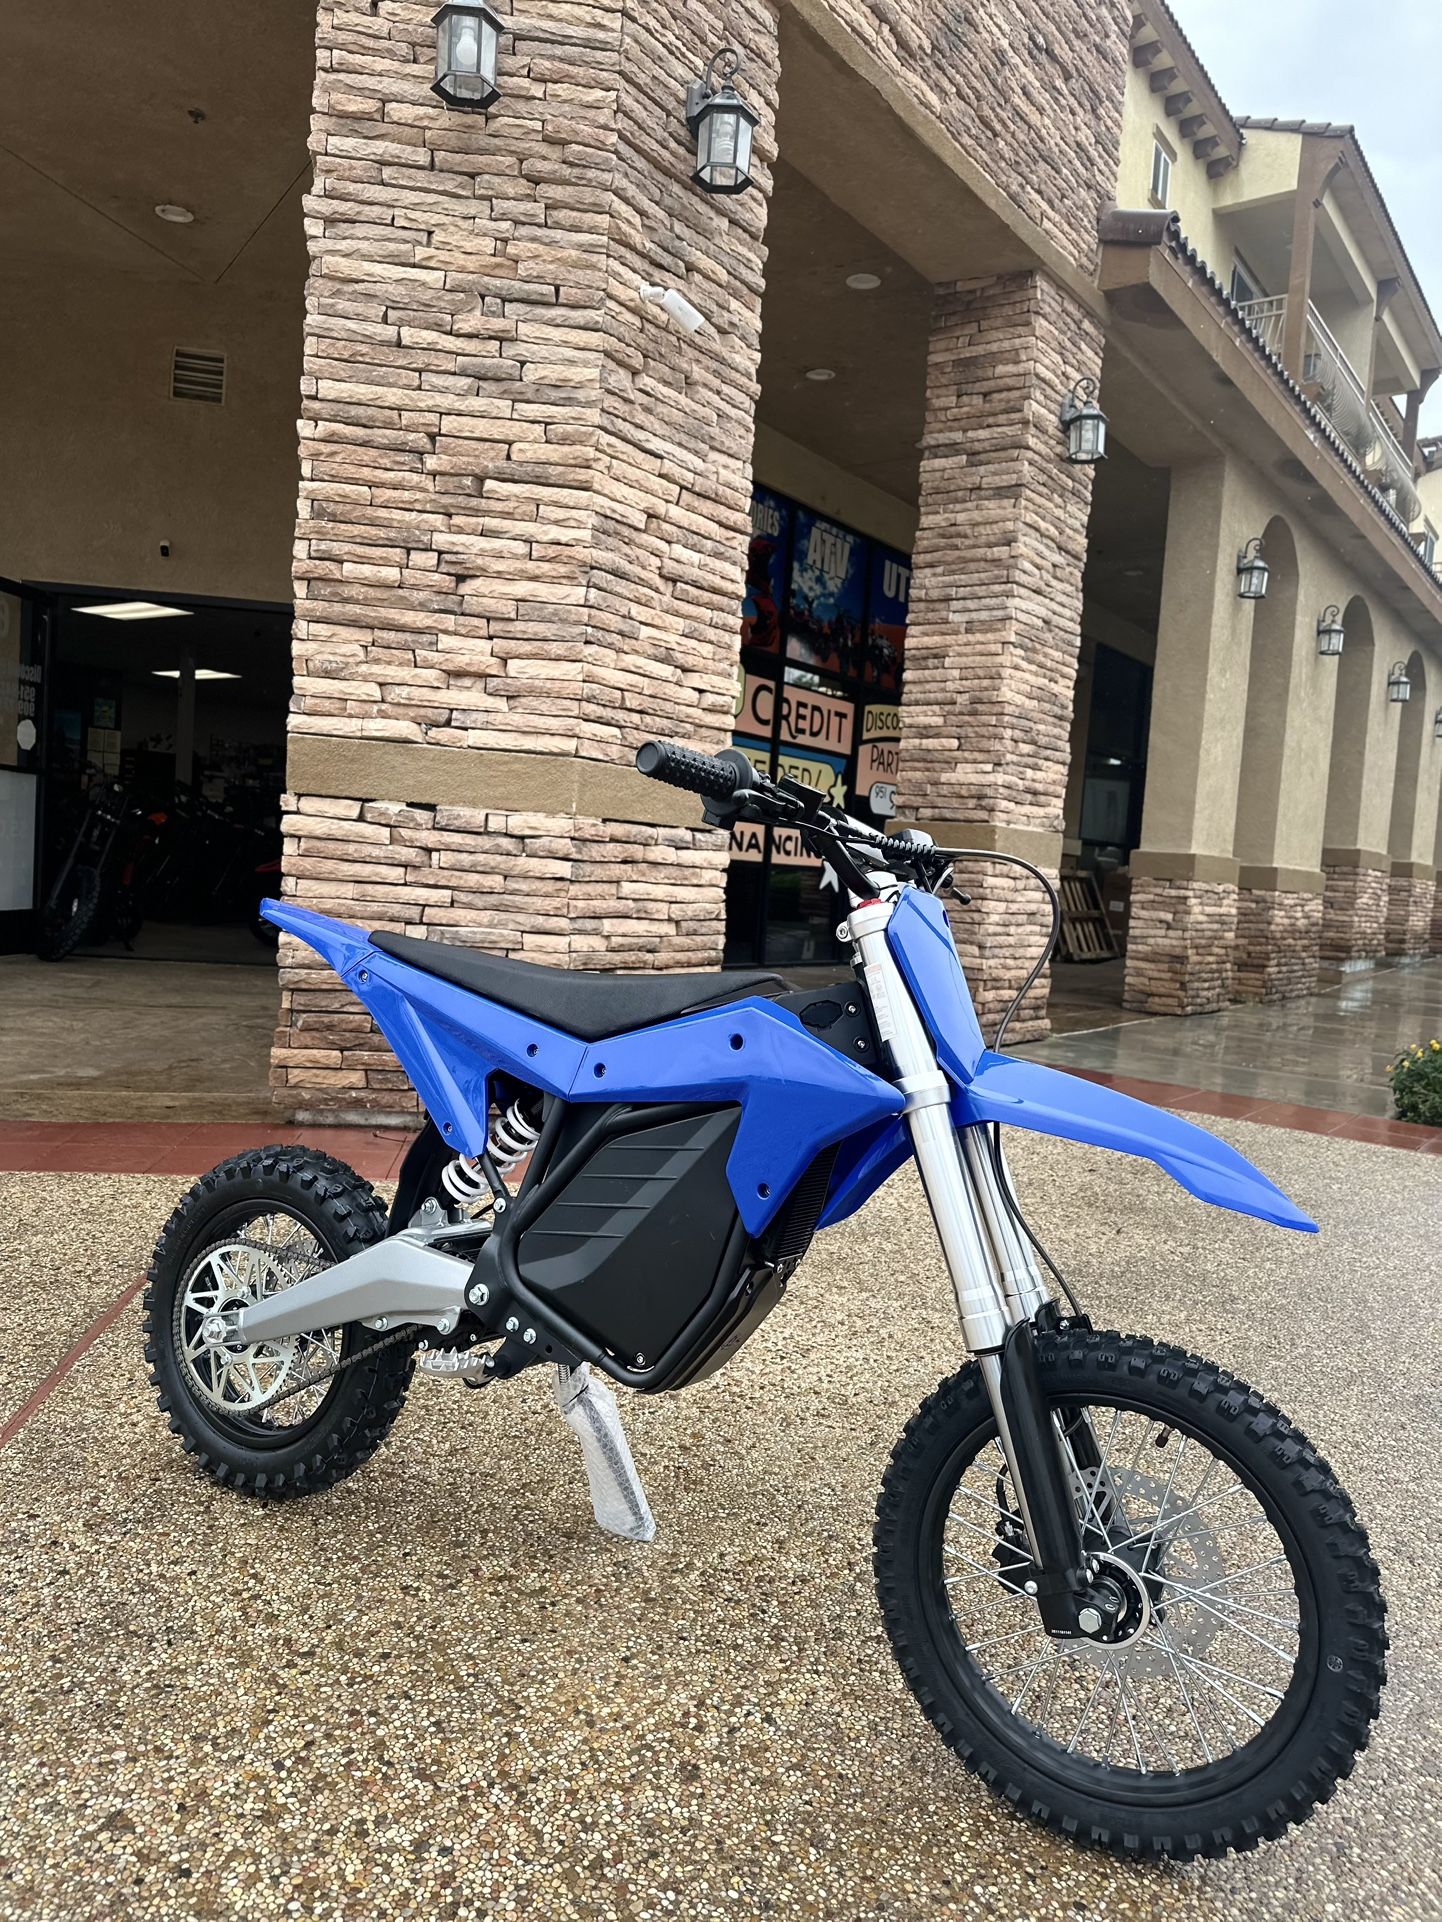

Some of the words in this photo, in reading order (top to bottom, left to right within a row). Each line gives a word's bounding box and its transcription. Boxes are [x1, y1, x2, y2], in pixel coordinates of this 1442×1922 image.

[807, 526, 851, 580] ATV
[751, 683, 848, 744] CREDIT
[865, 710, 901, 733] DISCO
